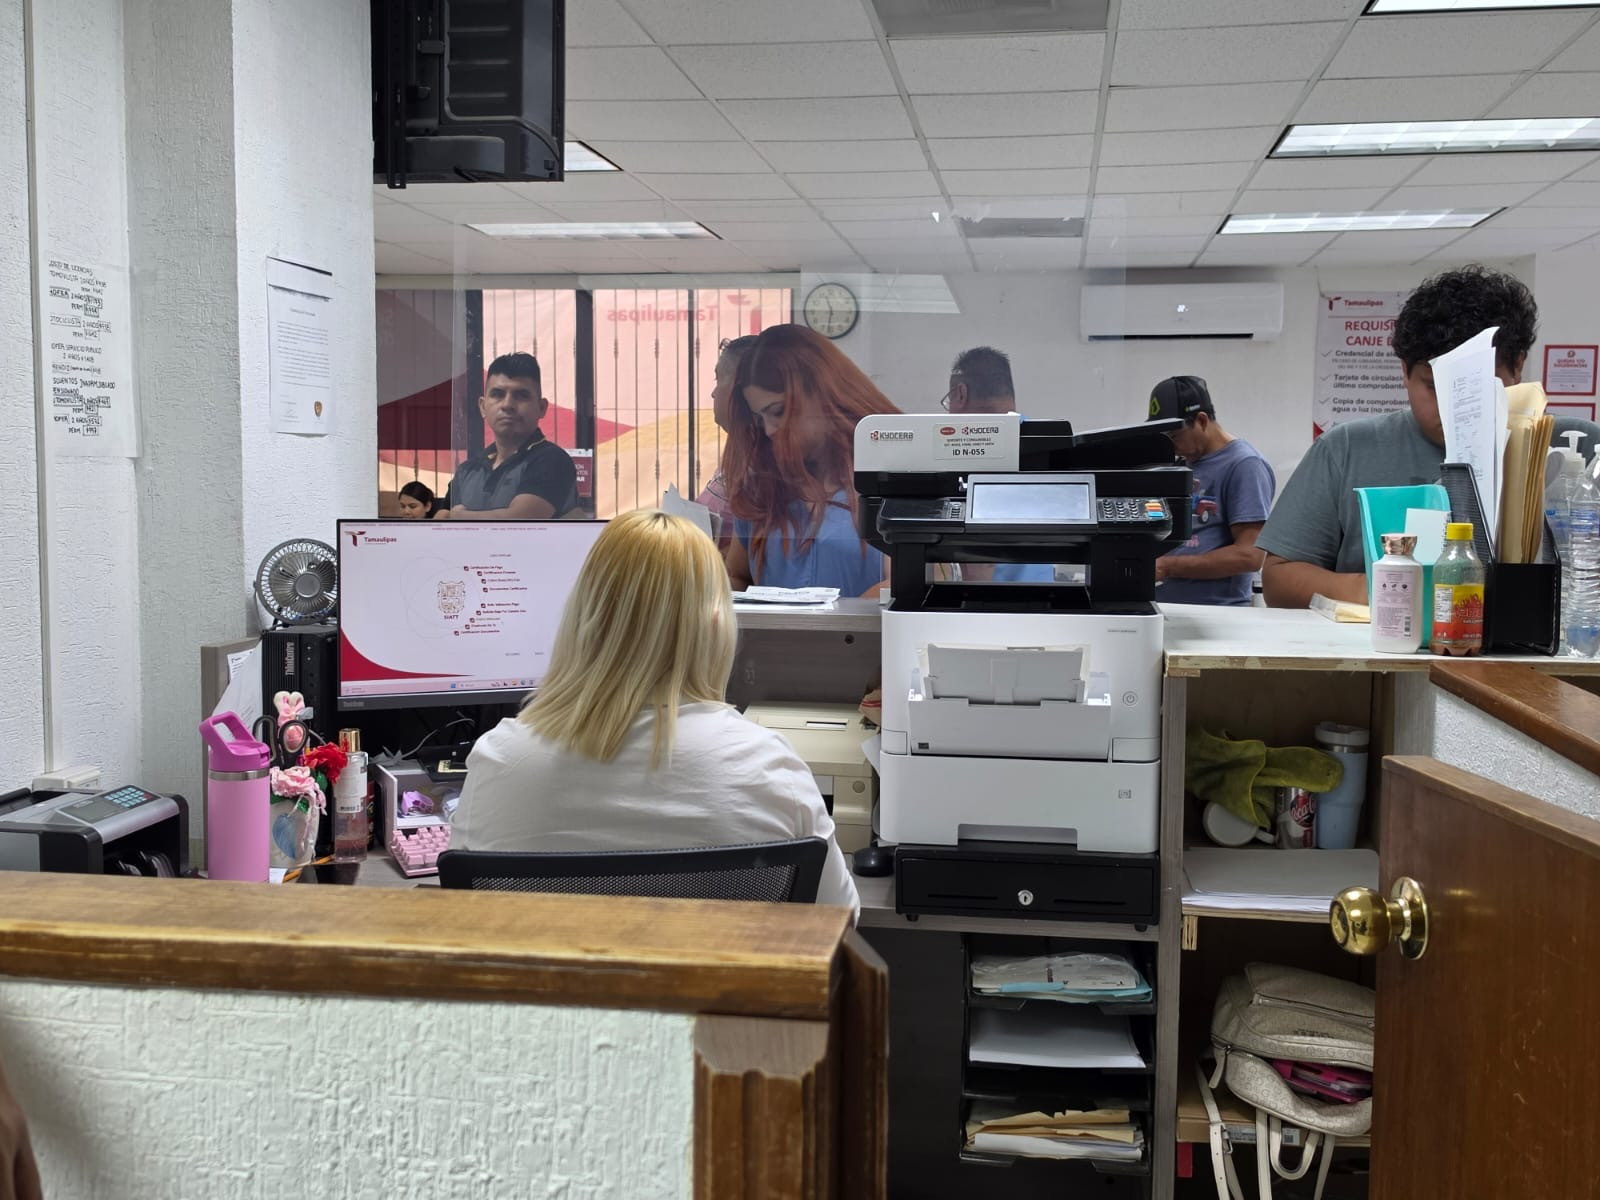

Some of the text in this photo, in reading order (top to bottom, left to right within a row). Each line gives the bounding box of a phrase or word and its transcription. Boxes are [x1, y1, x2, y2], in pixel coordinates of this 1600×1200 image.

[1346, 336, 1383, 346] CANJE
[1334, 374, 1359, 382] Tarjeta
[1332, 398, 1353, 406] Copia
[880, 432, 914, 440] KYOCERA
[962, 448, 985, 456] N-055
